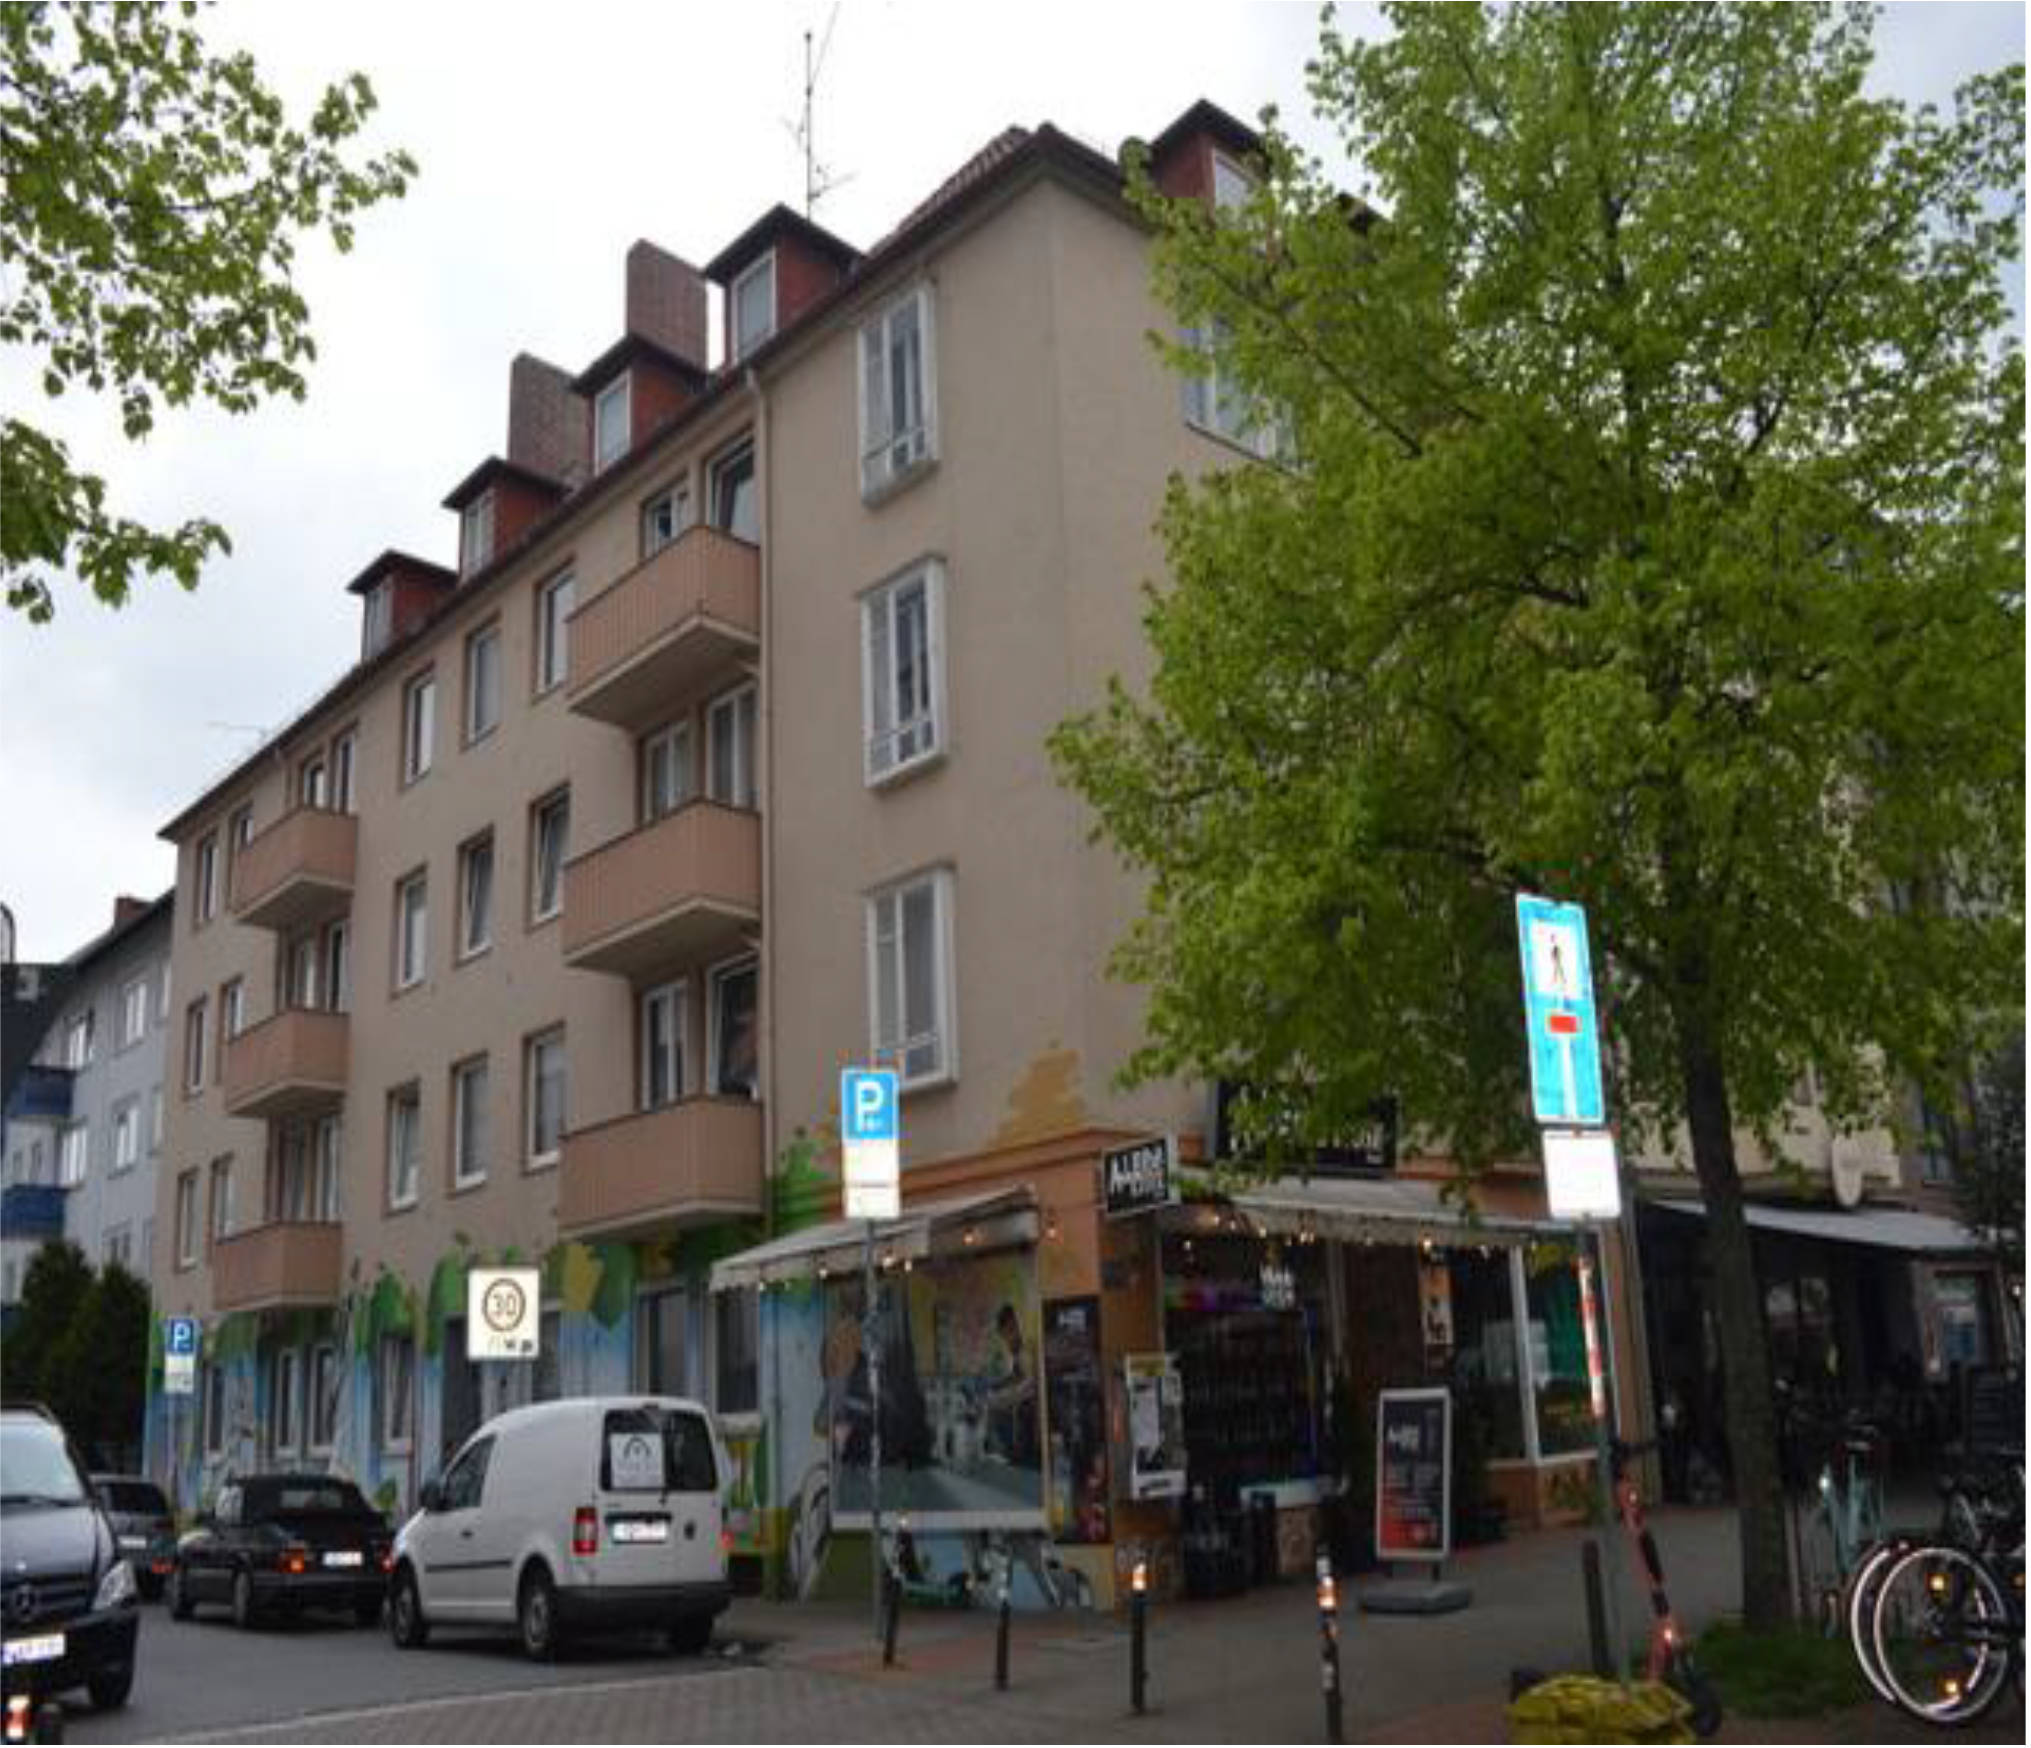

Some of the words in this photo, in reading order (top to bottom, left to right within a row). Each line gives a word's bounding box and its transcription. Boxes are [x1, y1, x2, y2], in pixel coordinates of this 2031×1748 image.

[856, 1081, 884, 1132] P
[493, 1294, 517, 1318] 30
[173, 1322, 191, 1351] P
